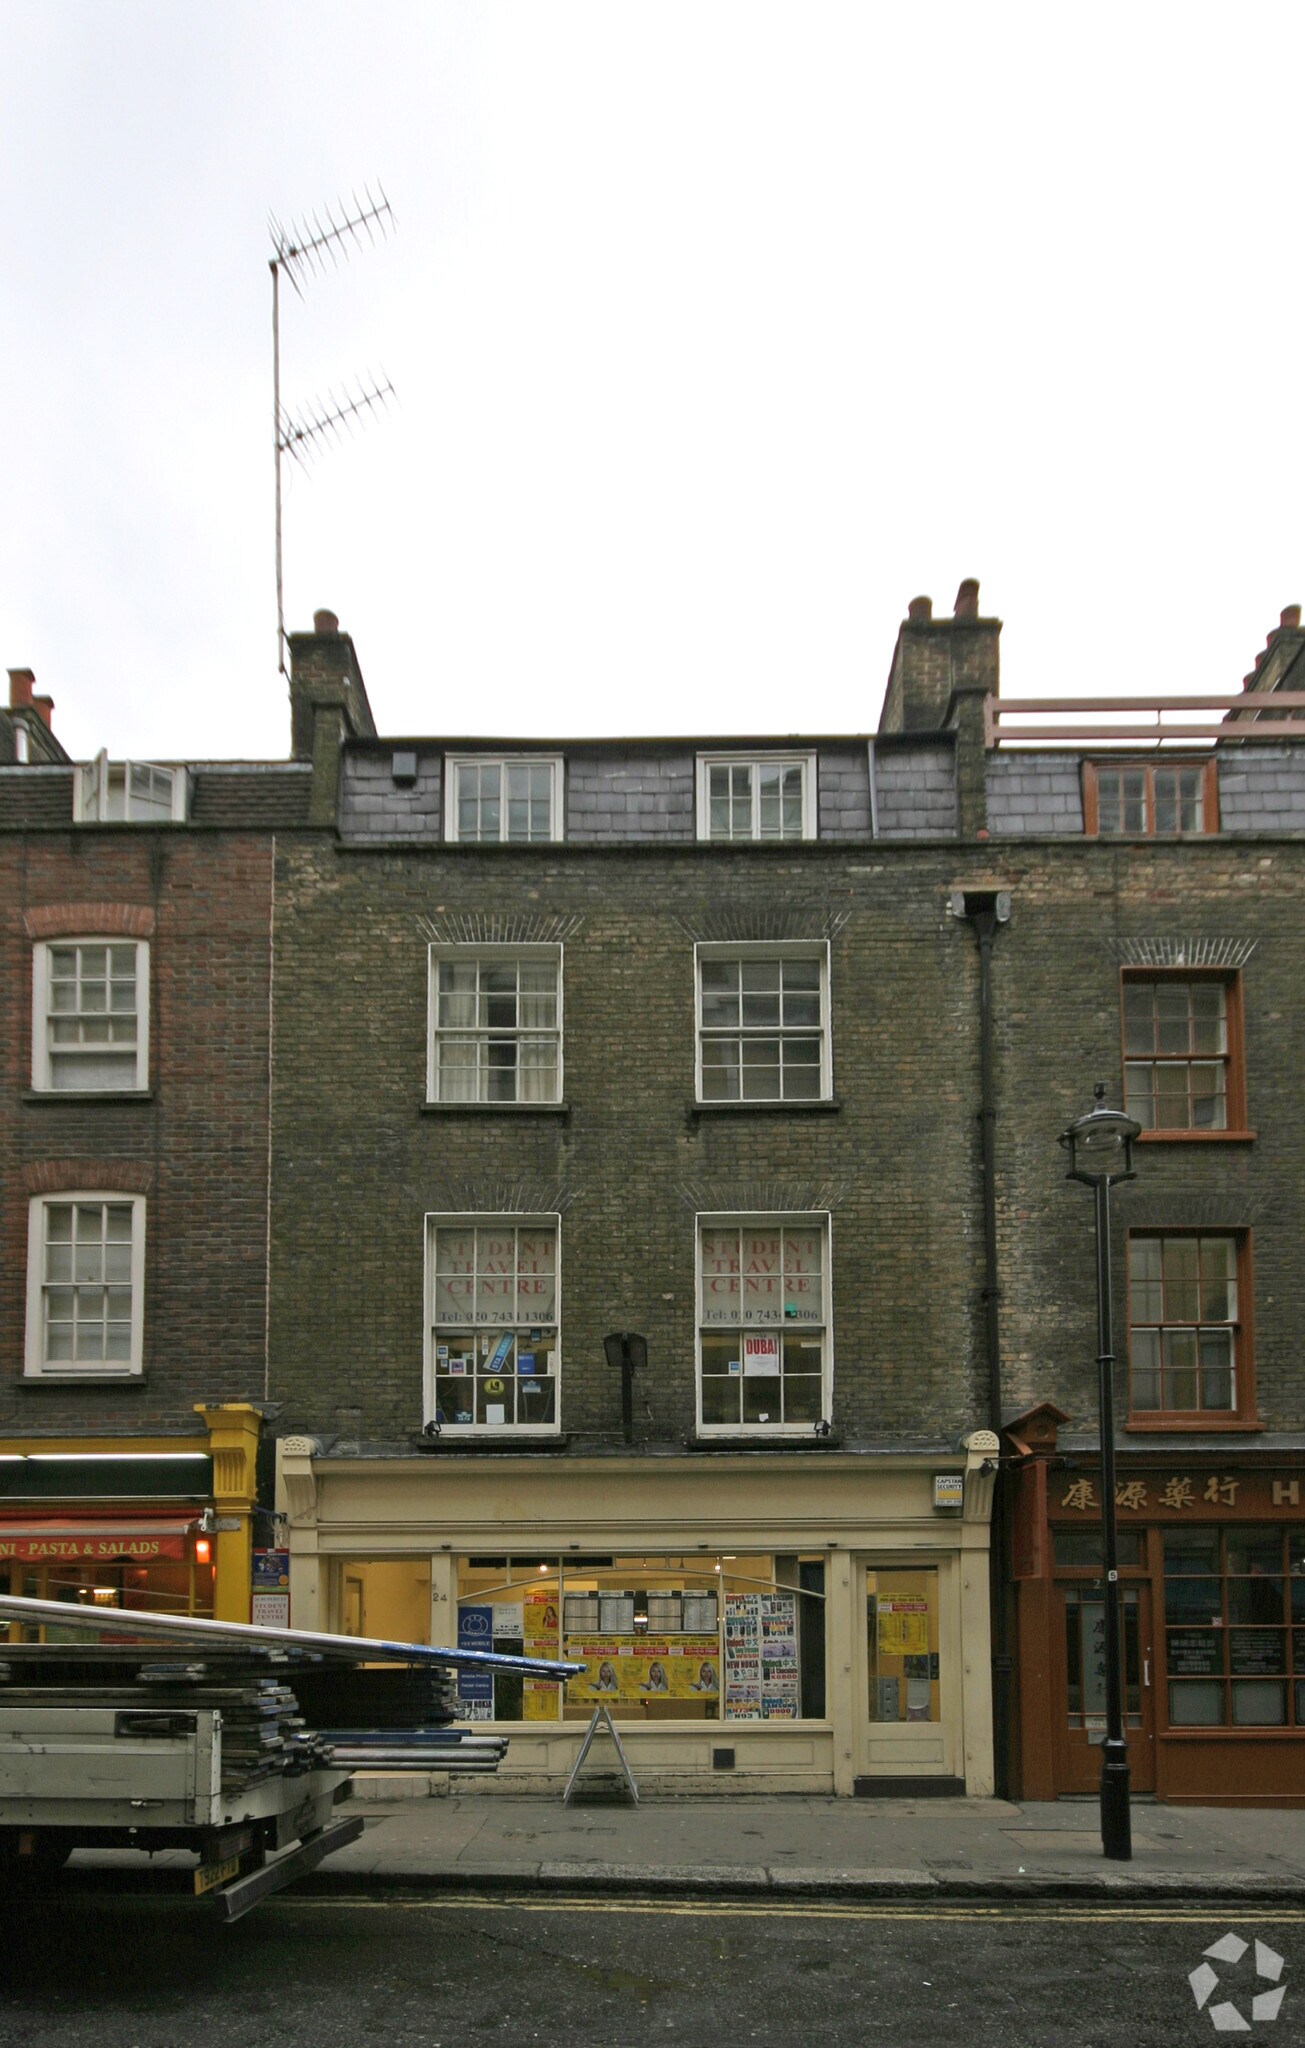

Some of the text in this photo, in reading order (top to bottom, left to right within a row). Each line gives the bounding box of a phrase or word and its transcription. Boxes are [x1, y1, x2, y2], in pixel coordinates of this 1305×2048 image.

[441, 1242, 554, 1256] STUDENT
[703, 1241, 815, 1255] STUDENT
[449, 1261, 544, 1274] TRAVEL
[711, 1259, 809, 1273] TRAVEL
[447, 1279, 547, 1294] CENTRE
[710, 1278, 811, 1293] CENTRE
[441, 1311, 462, 1321] Tel:
[525, 1312, 553, 1321] 1306
[705, 1311, 727, 1320] Tel:
[731, 1311, 753, 1320] 00
[757, 1311, 782, 1320] 743
[746, 1339, 777, 1355] DUBAI
[28, 1542, 79, 1555] PASTA
[83, 1542, 94, 1554] &
[98, 1541, 160, 1554] SALADS
[433, 1592, 448, 1602] 24
[727, 1660, 759, 1669] NEW NOKIA
[474, 1700, 492, 1708] NOKIA
